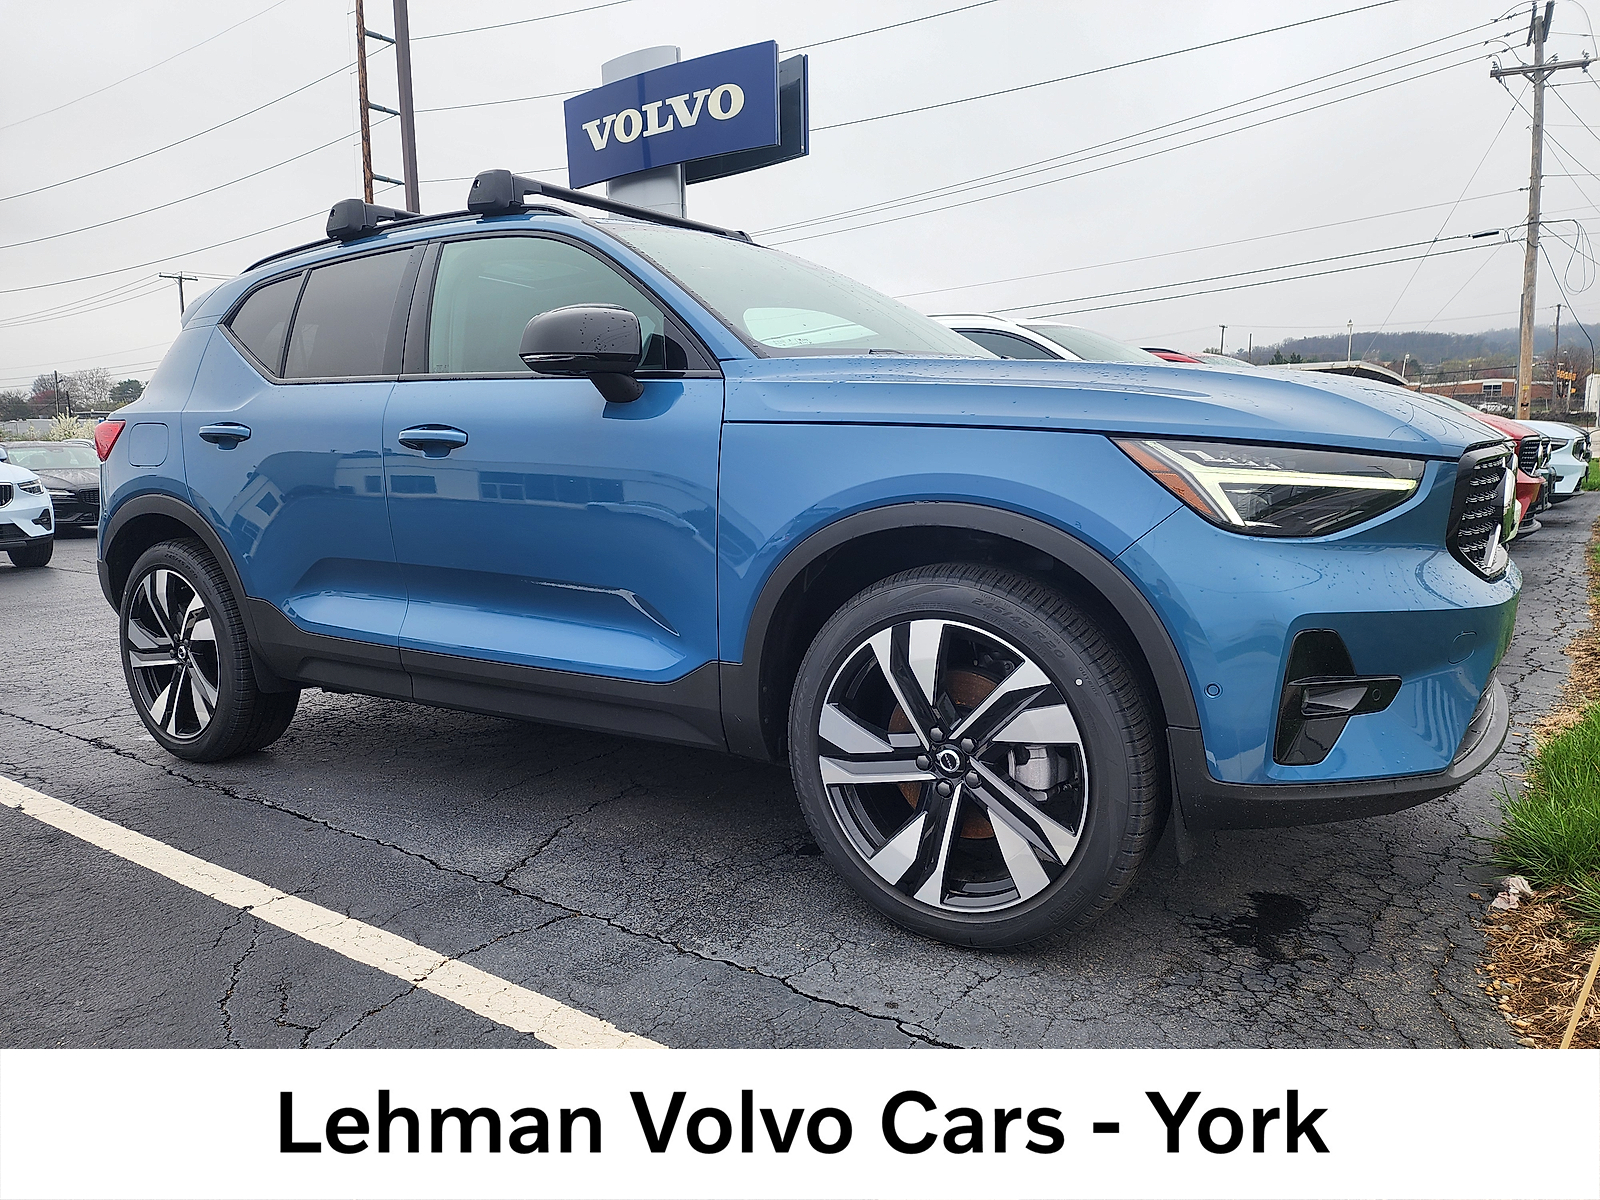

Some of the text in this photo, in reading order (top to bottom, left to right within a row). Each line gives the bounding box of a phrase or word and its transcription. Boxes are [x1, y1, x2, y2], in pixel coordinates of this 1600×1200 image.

[581, 83, 745, 151] VOLVO
[971, 597, 1032, 629] 245/45
[1032, 630, 1066, 659] R20
